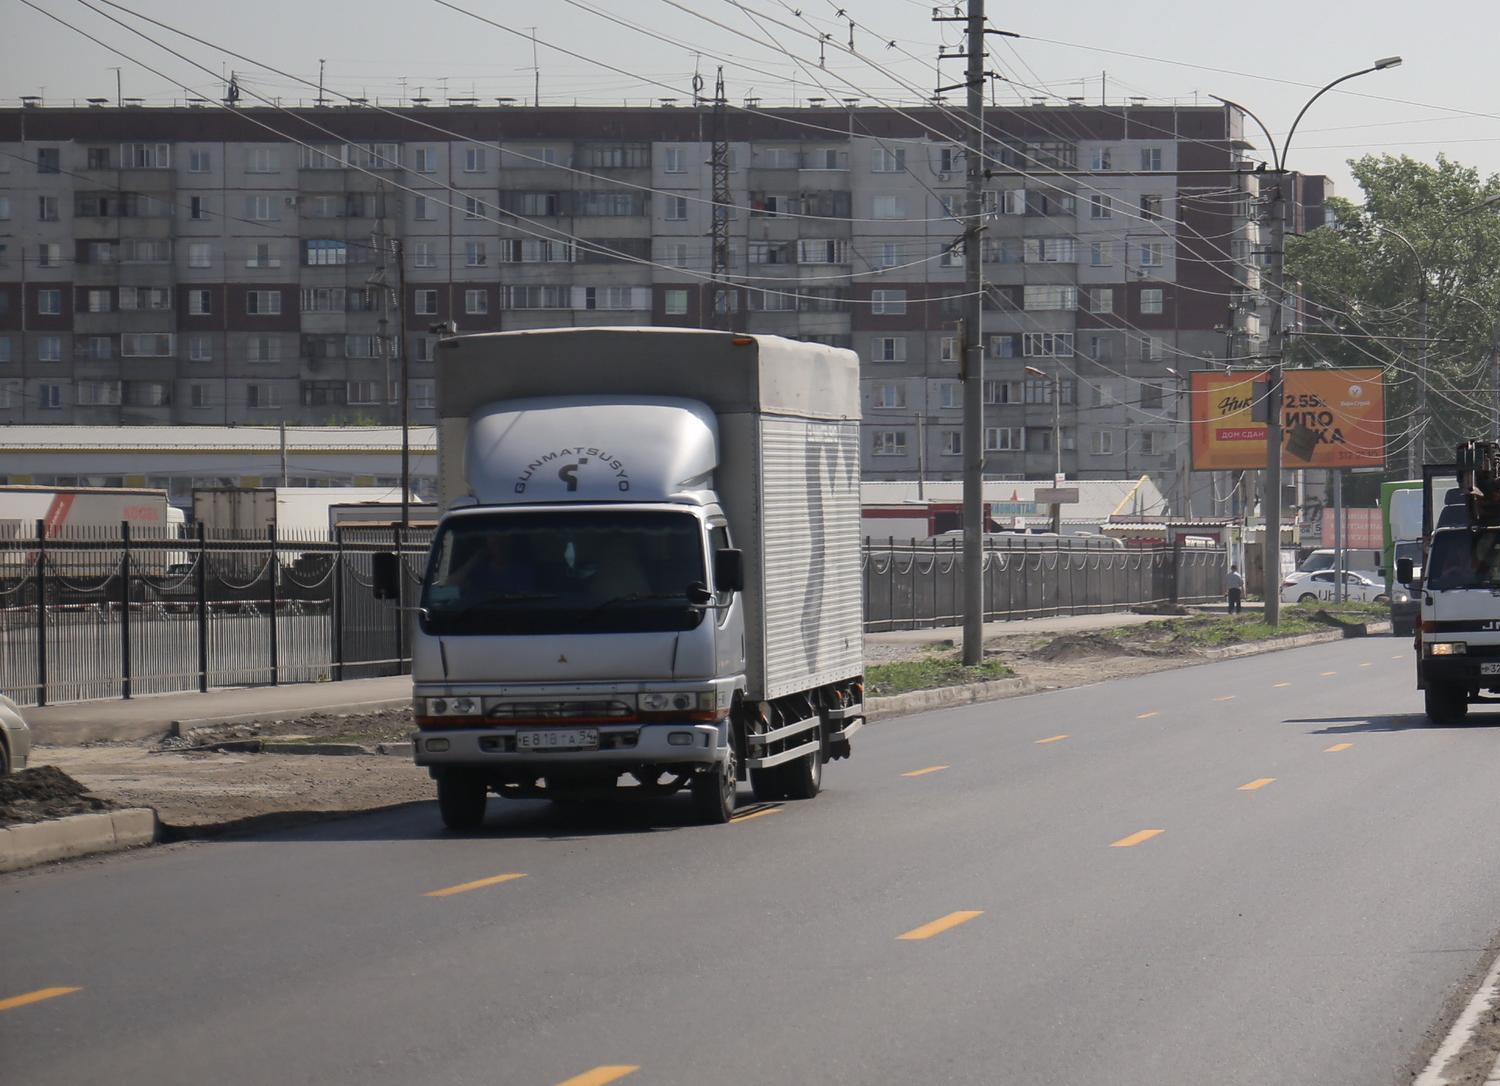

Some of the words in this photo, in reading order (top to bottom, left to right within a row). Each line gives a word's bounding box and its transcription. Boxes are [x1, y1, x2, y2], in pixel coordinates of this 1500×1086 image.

[1222, 431, 1240, 439] ДОМ
[1241, 431, 1264, 439] СДАН
[514, 447, 630, 494] GUNMATSUSYO
